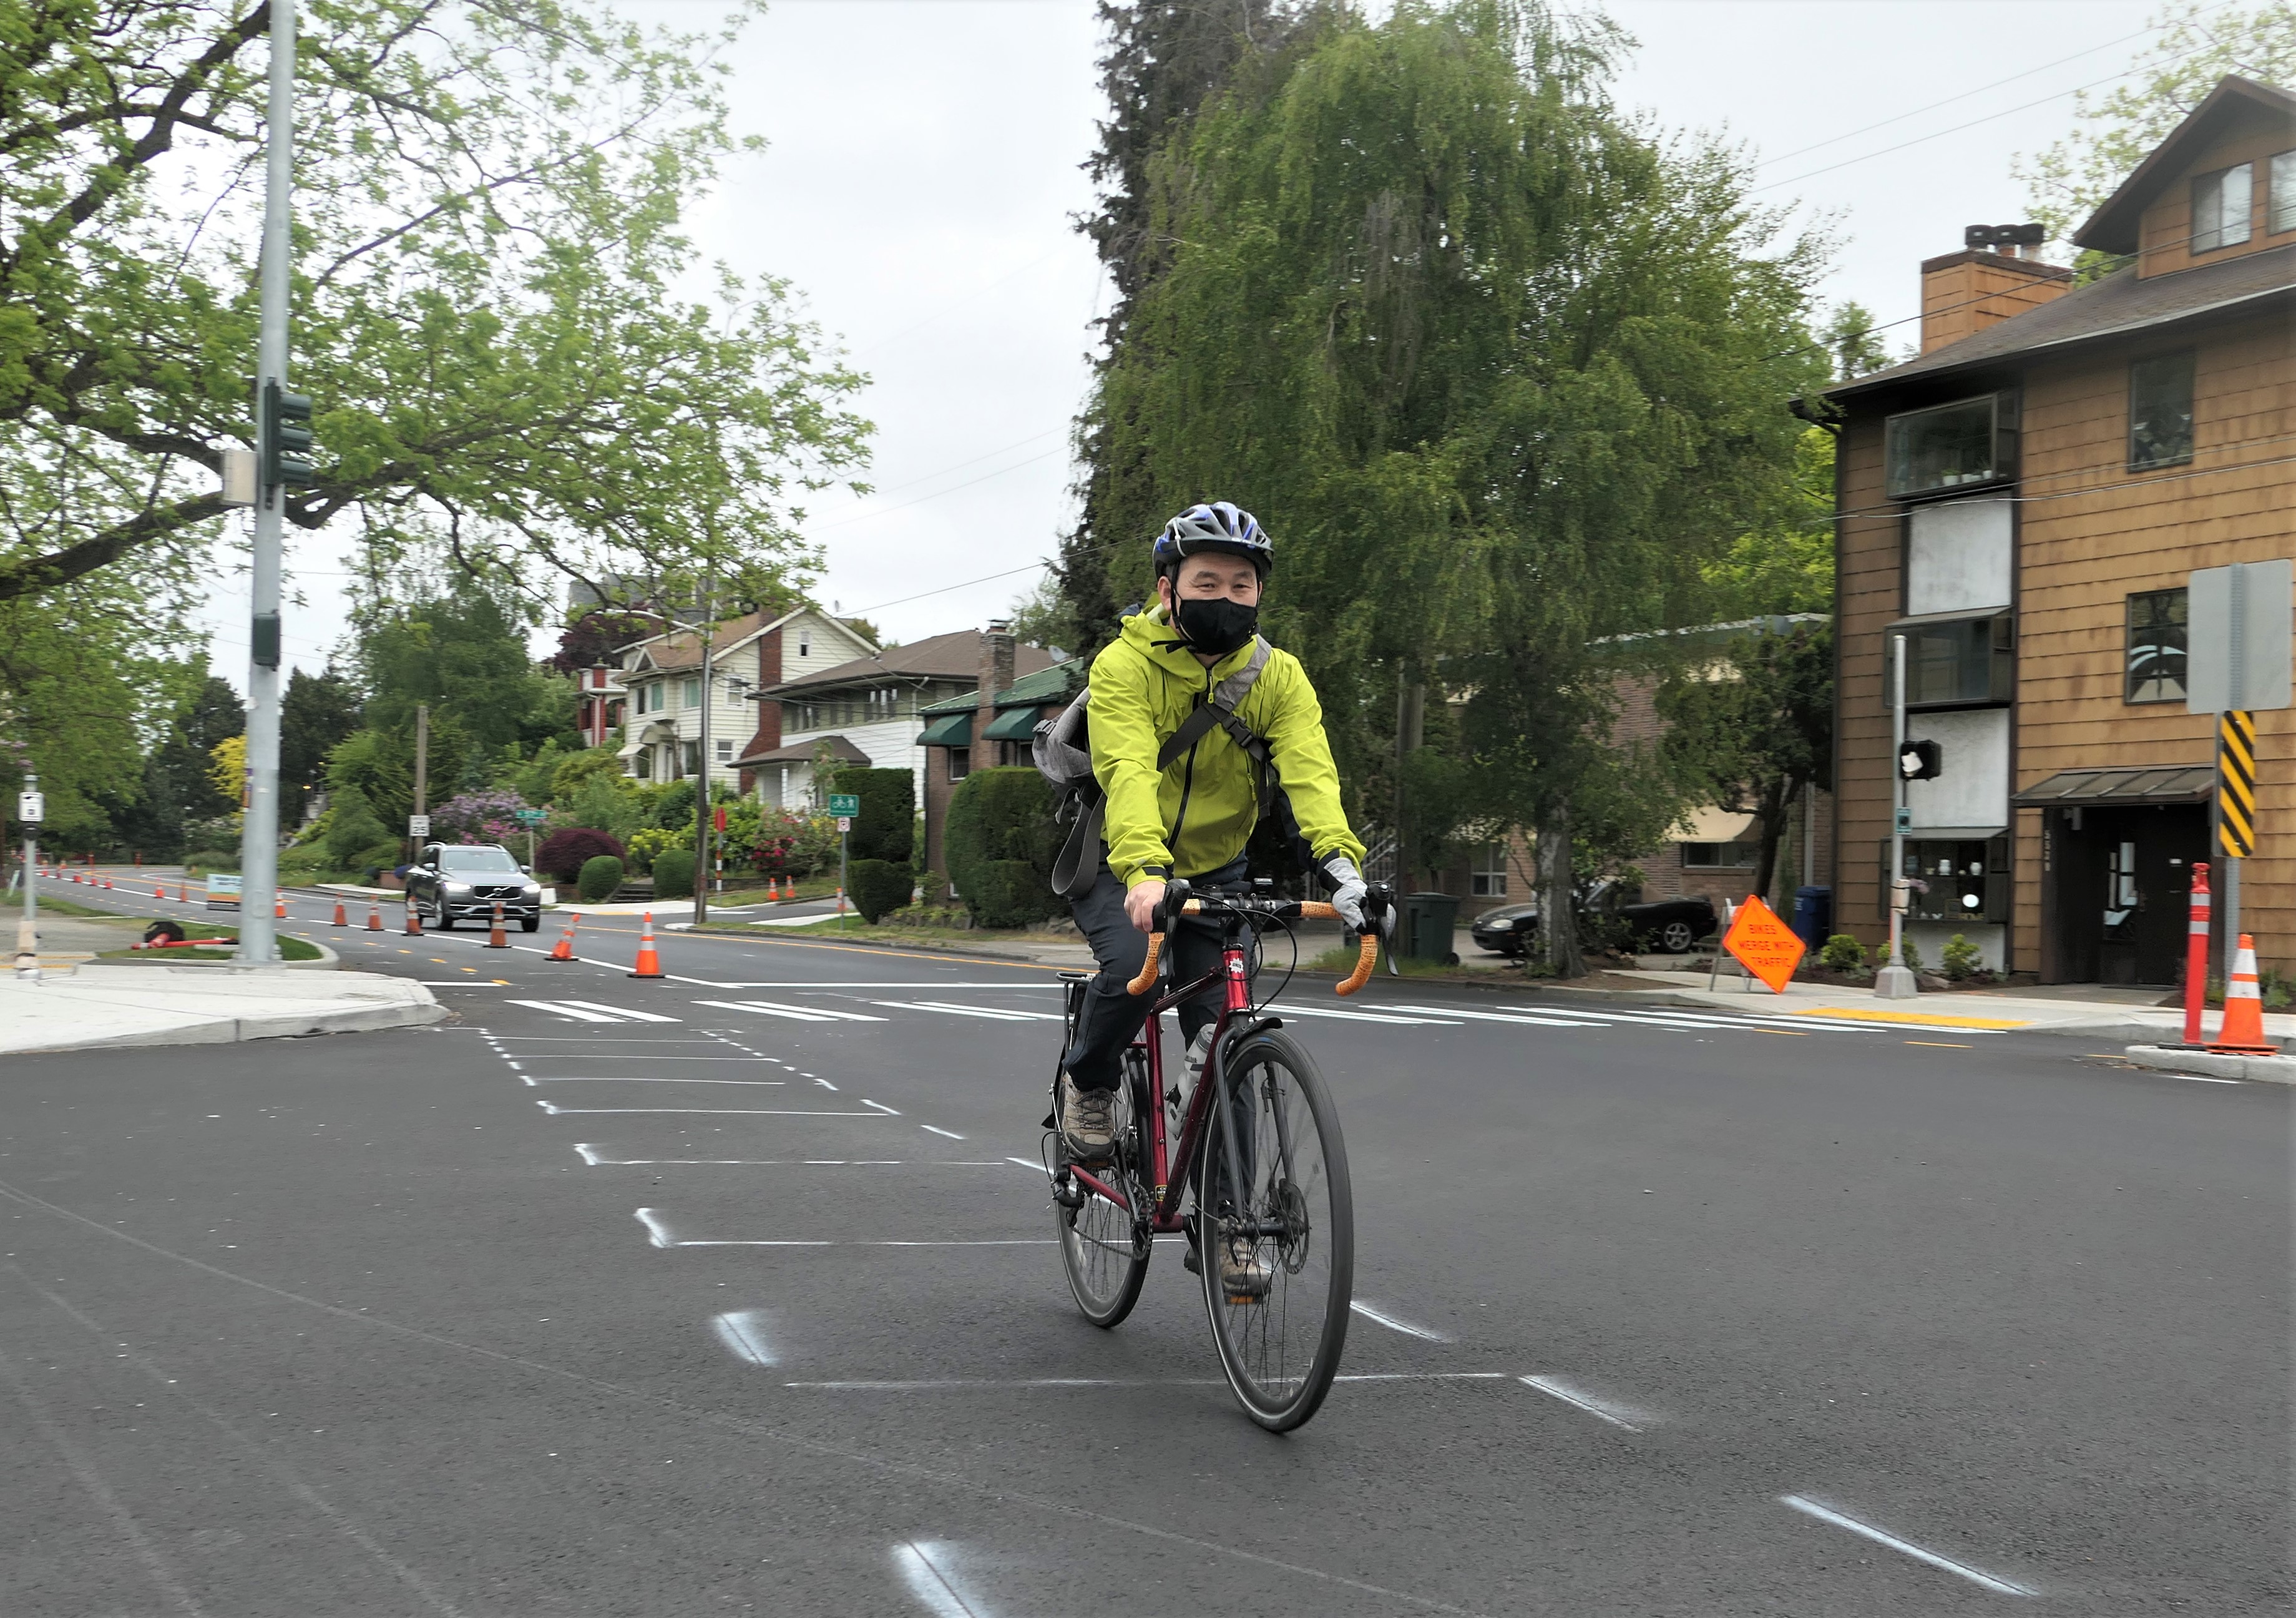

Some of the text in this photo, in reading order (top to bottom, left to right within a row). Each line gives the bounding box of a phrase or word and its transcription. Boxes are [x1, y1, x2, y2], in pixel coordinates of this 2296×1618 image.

[1748, 924, 1777, 934] BIKES
[1737, 940, 1797, 951] MERGE WITH
[1751, 957, 1792, 968] TRAFFIC
